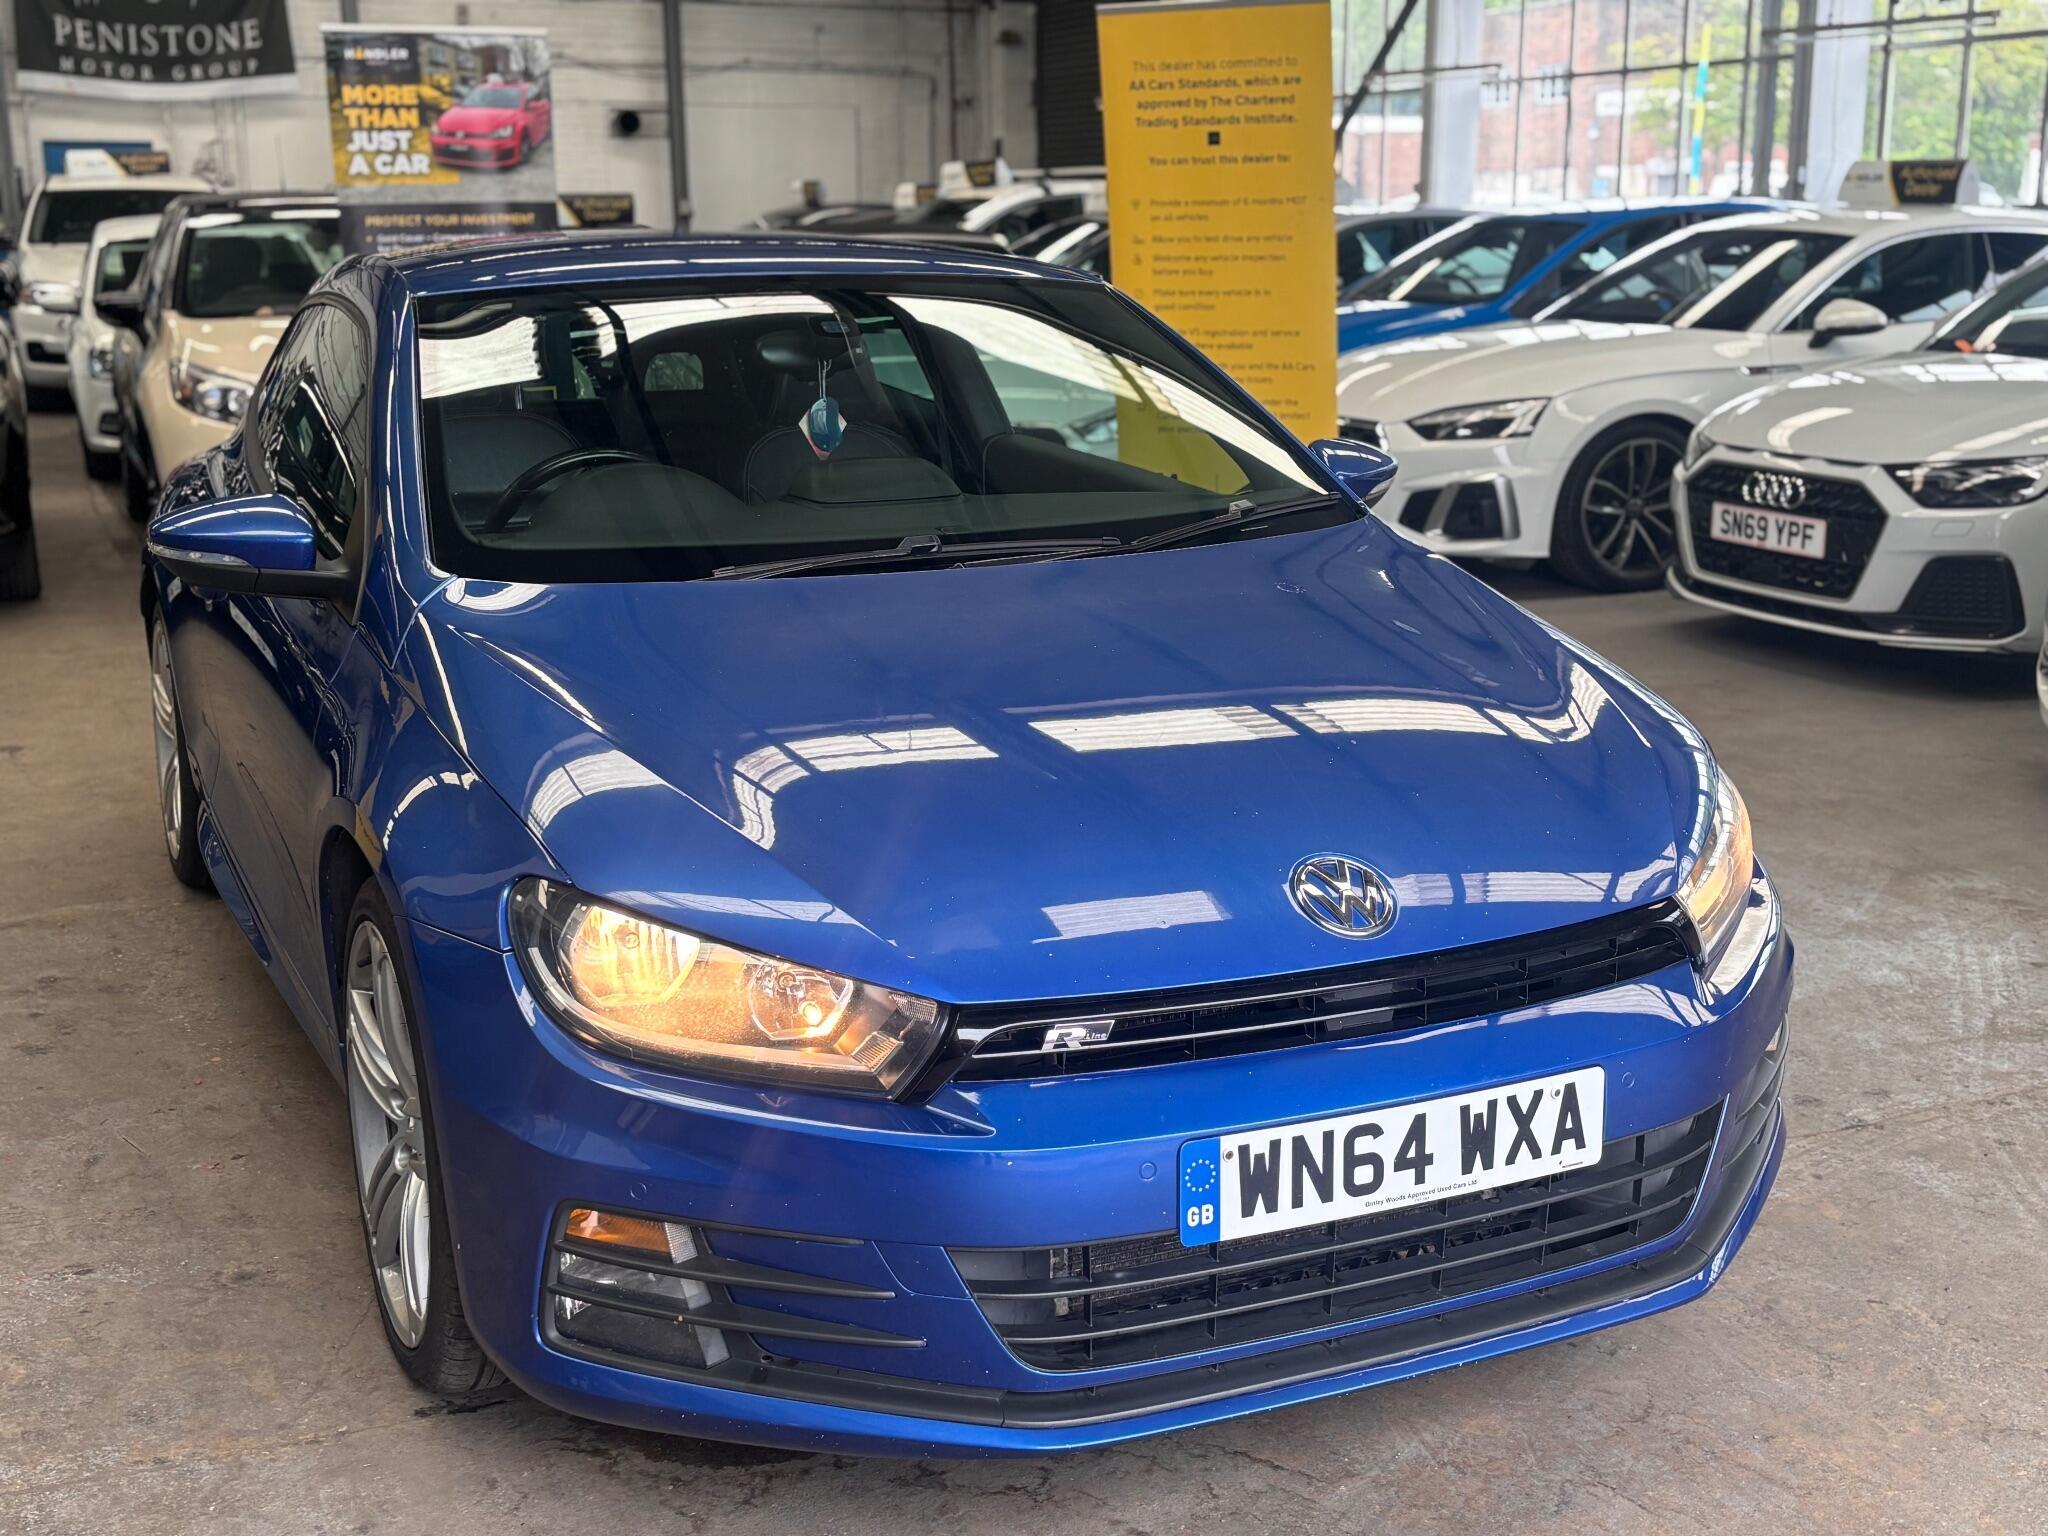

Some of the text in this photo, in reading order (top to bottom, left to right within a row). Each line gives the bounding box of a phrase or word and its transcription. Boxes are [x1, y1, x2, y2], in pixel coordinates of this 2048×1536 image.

[52, 13, 263, 57] PENISTONE
[58, 55, 260, 82] MOTOR GROUP
[1132, 56, 1298, 73] This dealer has committed to
[341, 83, 419, 106] MORE
[1129, 80, 1146, 92] AA
[1148, 79, 1174, 91] Cars
[1245, 75, 1280, 87] which
[1283, 75, 1302, 86] are
[1136, 94, 1296, 112] approved by The Chartered
[343, 106, 420, 129] THAN
[1135, 117, 1179, 129] Trading
[1182, 115, 1241, 127] Standards
[346, 129, 413, 152] JUST
[348, 153, 431, 176] A CAR
[1149, 156, 1169, 167] You
[1171, 156, 1189, 166] can
[1191, 154, 1217, 166] trust
[1219, 154, 1239, 165] this
[1241, 153, 1274, 165] dealer
[365, 213, 422, 228] PROTECT
[425, 213, 460, 227] YOUR
[1720, 508, 1816, 550] SN69 YPF
[1237, 1081, 1587, 1219] WN64 WXA
[1385, 1194, 1406, 1204] Woods
[1407, 1187, 1436, 1200] Approved
[1436, 1184, 1452, 1194] Used
[1452, 1182, 1467, 1191] Cars
[1186, 1203, 1214, 1227] GB
